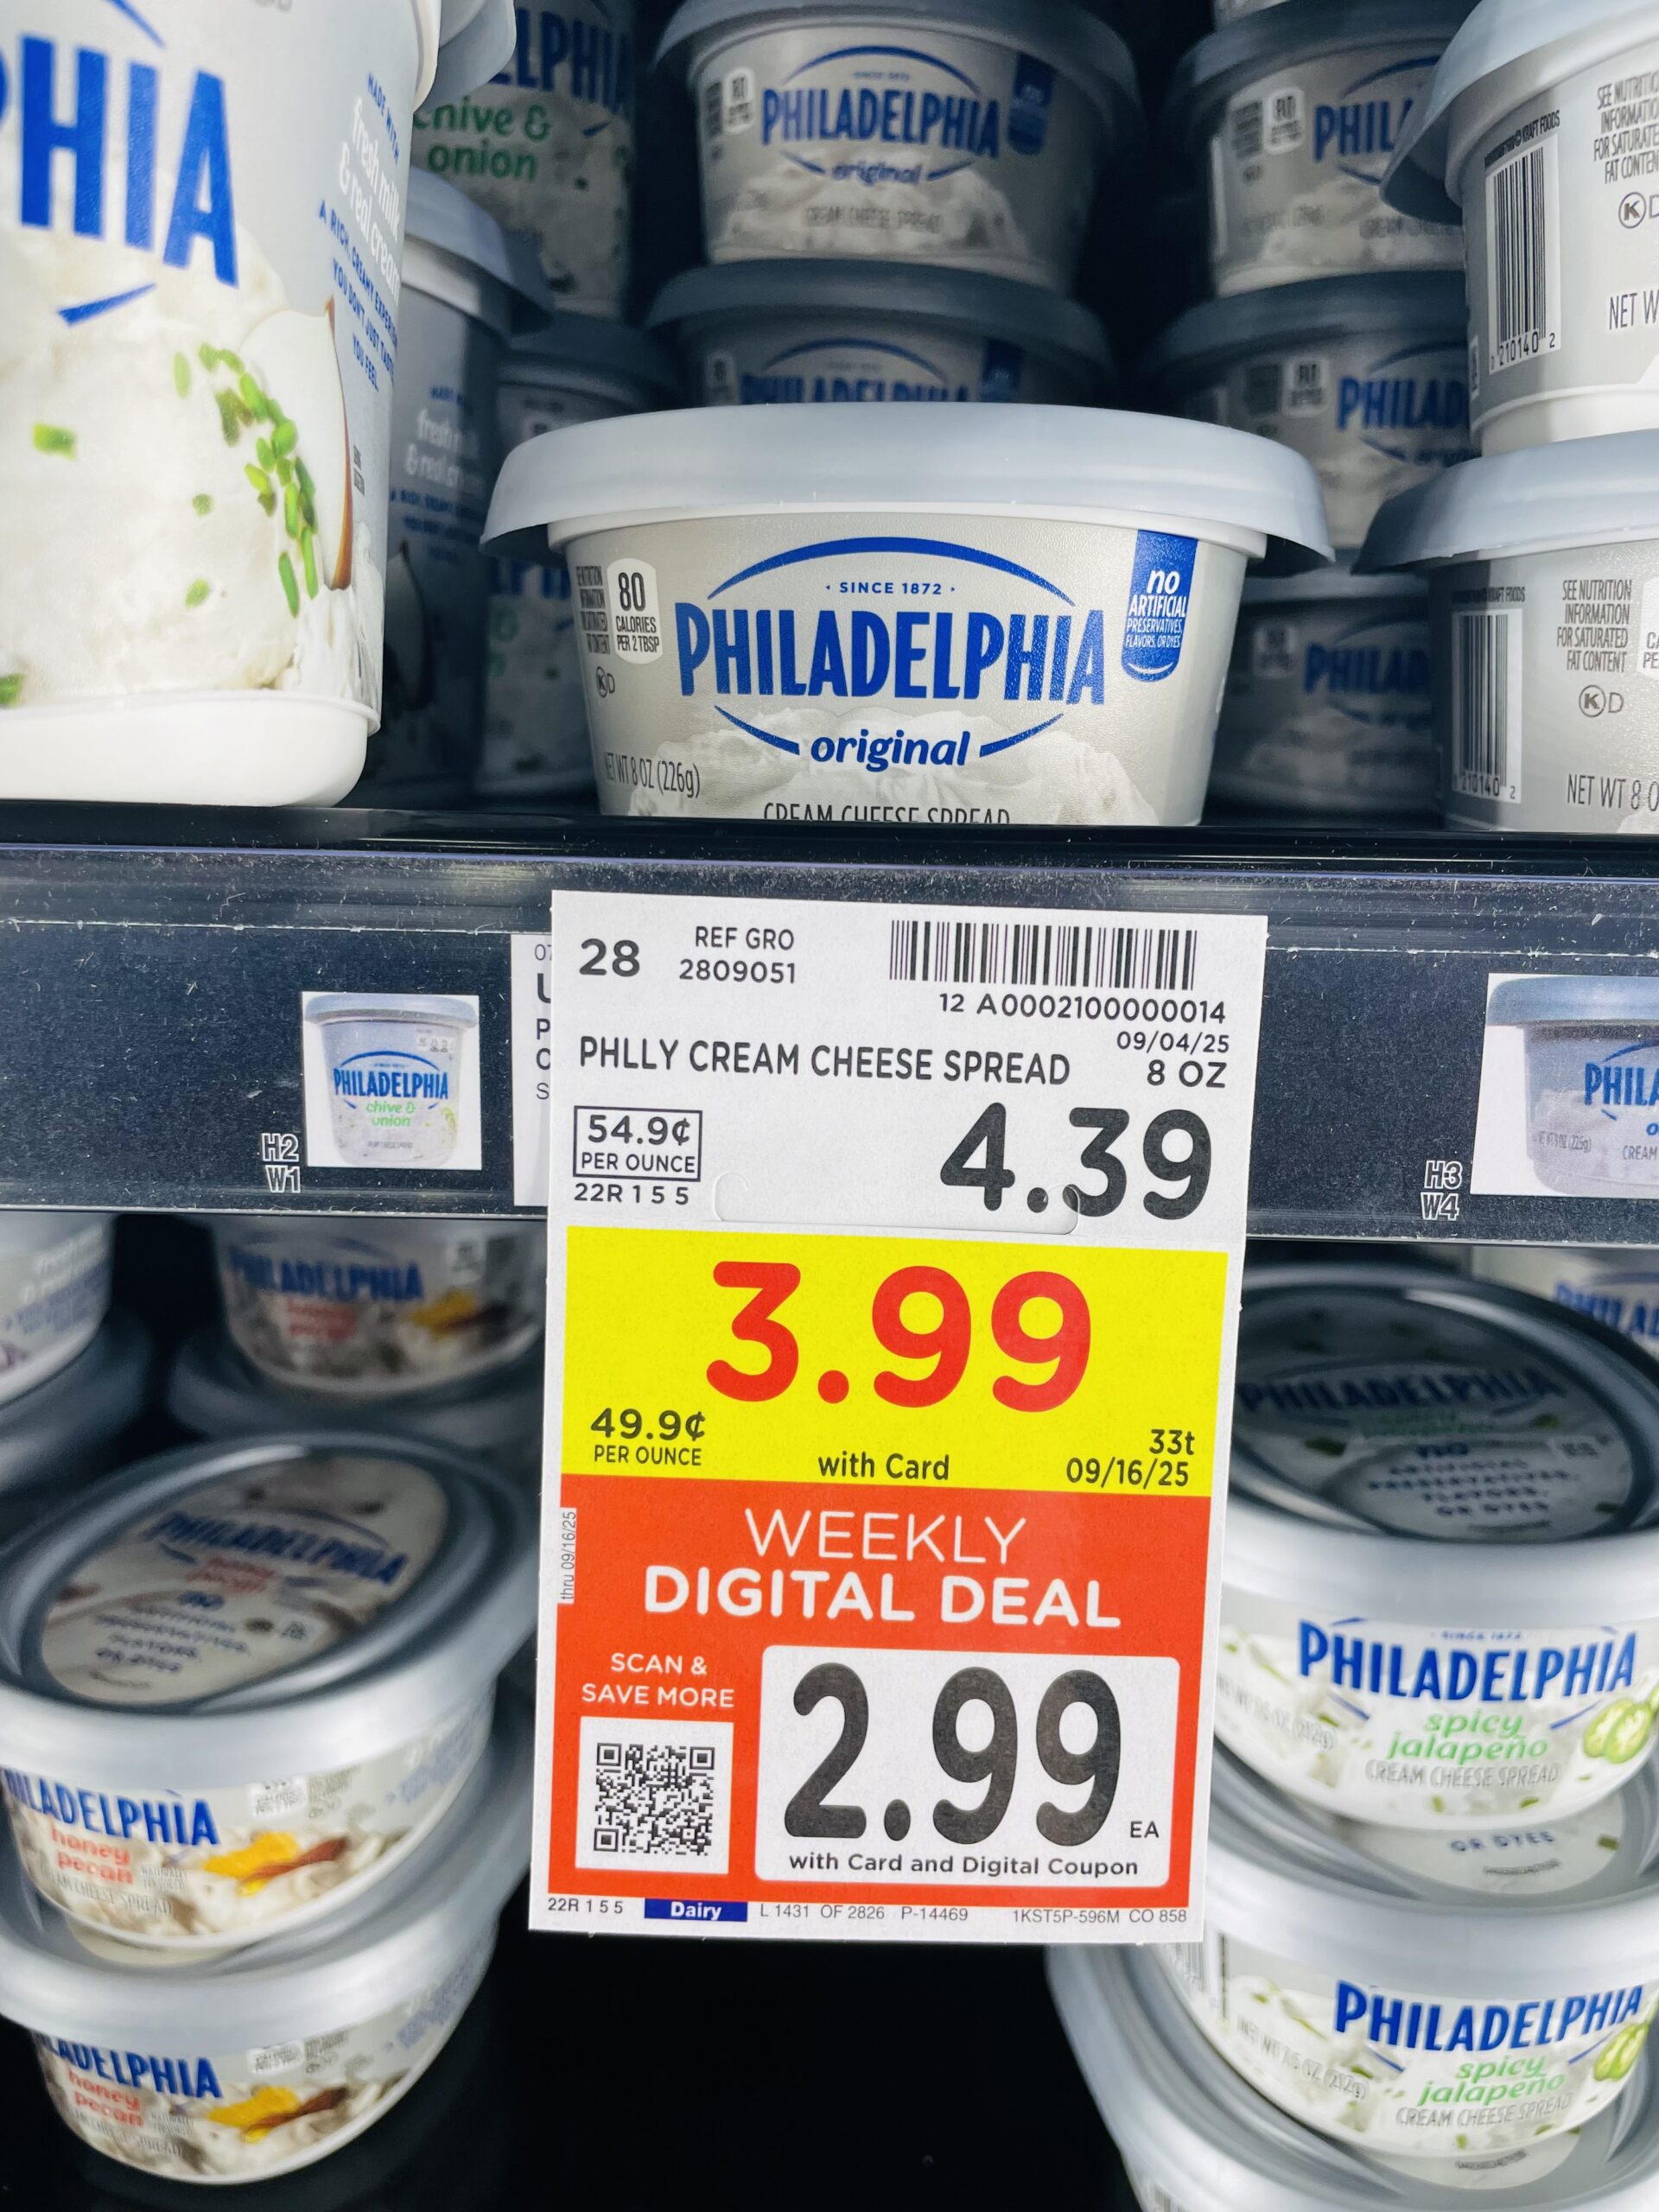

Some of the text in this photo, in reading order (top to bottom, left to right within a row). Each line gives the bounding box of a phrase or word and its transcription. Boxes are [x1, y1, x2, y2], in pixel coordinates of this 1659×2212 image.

[367, 72, 386, 118] MADE
[1598, 84, 1612, 110] SEE
[760, 86, 1000, 158] PHILADELPHIA
[1313, 98, 1413, 162] PHIL
[1540, 110, 1560, 135] FOODS
[429, 138, 537, 180] onion
[1594, 137, 1610, 162] FOR
[353, 96, 400, 243] fresh milk
[832, 161, 923, 185] original
[1605, 158, 1619, 184] FAT
[319, 199, 327, 225] A
[340, 141, 401, 306] & real cream
[333, 257, 347, 297] YOU
[365, 317, 380, 353] JUST
[1609, 292, 1638, 330] NET
[353, 332, 365, 368] YOU
[1549, 333, 1555, 348] 2
[618, 572, 646, 612] 80
[838, 582, 943, 595] SINCE 1872
[1147, 570, 1180, 594] no
[1562, 580, 1632, 601] SEE NUTRITION
[1128, 594, 1187, 618] ARTIFICIAL
[1565, 604, 1630, 625] INFORMATION
[616, 615, 657, 633] CALORIES
[1557, 626, 1628, 649] FOR SATURATED
[617, 635, 659, 653] PER 2 TBSP
[675, 602, 1105, 705] PHILADELPHIA
[1567, 651, 1627, 673] FAT CONTENT
[811, 730, 969, 772] original
[631, 757, 637, 785] 8
[639, 759, 655, 789] OZ
[657, 760, 700, 798] (226g)
[1567, 774, 1642, 810] NET WT 8
[1510, 785, 1516, 800] 2
[696, 926, 794, 950] REF GRO
[579, 938, 640, 977] 28
[679, 958, 796, 984] 2809051
[939, 994, 1226, 1024] 12 A0002100000014
[1116, 1030, 1230, 1053] 09/04/25
[580, 1035, 1226, 1089] PHLLY CREAM CHEESE SPREAD 8 OZ
[334, 1067, 448, 1100] PHILADELPHIA
[365, 1101, 403, 1115] chive
[588, 1114, 691, 1146] 54.9¢
[261, 1133, 300, 1162] H2
[940, 1103, 1211, 1220] 4.39
[1623, 1145, 1657, 1160] CREAM
[581, 1152, 696, 1173] PER OUNCE
[1423, 1160, 1464, 1191] H3
[264, 1164, 302, 1193] W1
[574, 1183, 690, 1205] 22R 1 5 5
[1420, 1192, 1460, 1221] W4
[706, 1261, 1090, 1412] 3.99
[591, 1408, 1196, 1456] 49.9¢ 33t
[594, 1445, 702, 1466] PER OUNCE
[818, 1452, 950, 1481] with Card
[1065, 1458, 1190, 1488] 09/16/25
[745, 1508, 1027, 1563] WEEKLY
[560, 1511, 576, 1600] thru 09/16/25
[645, 1566, 1122, 1628] DIGITAL DEAL
[610, 1653, 708, 1676] SCAN &
[1298, 1618, 1638, 1702] PHILADELPHIA
[582, 1683, 734, 1708] SAVE MORE
[1426, 1710, 1524, 1738] spicy
[784, 1662, 1121, 1847] 2.99
[1365, 1759, 1562, 1788] CREAM CHEESE SPREAD
[51, 1821, 131, 1867] honey
[1129, 1821, 1159, 1839] EA
[1493, 1831, 1555, 1847] DYES
[57, 1852, 134, 1885] pecan
[789, 1853, 1139, 1881] with Card and Digital Coupon
[548, 1898, 1187, 1923] 22R 1 5 5 Dairy L 1431 OF 2826 P-14469 1KST5P-596M CO 858
[1335, 1980, 1643, 2052] PHILADELPHIA
[1455, 2054, 1549, 2084] spicy
[67, 2067, 140, 2112] honey
[1395, 2092, 1573, 2127] CREAM CHEESE SPREAD
